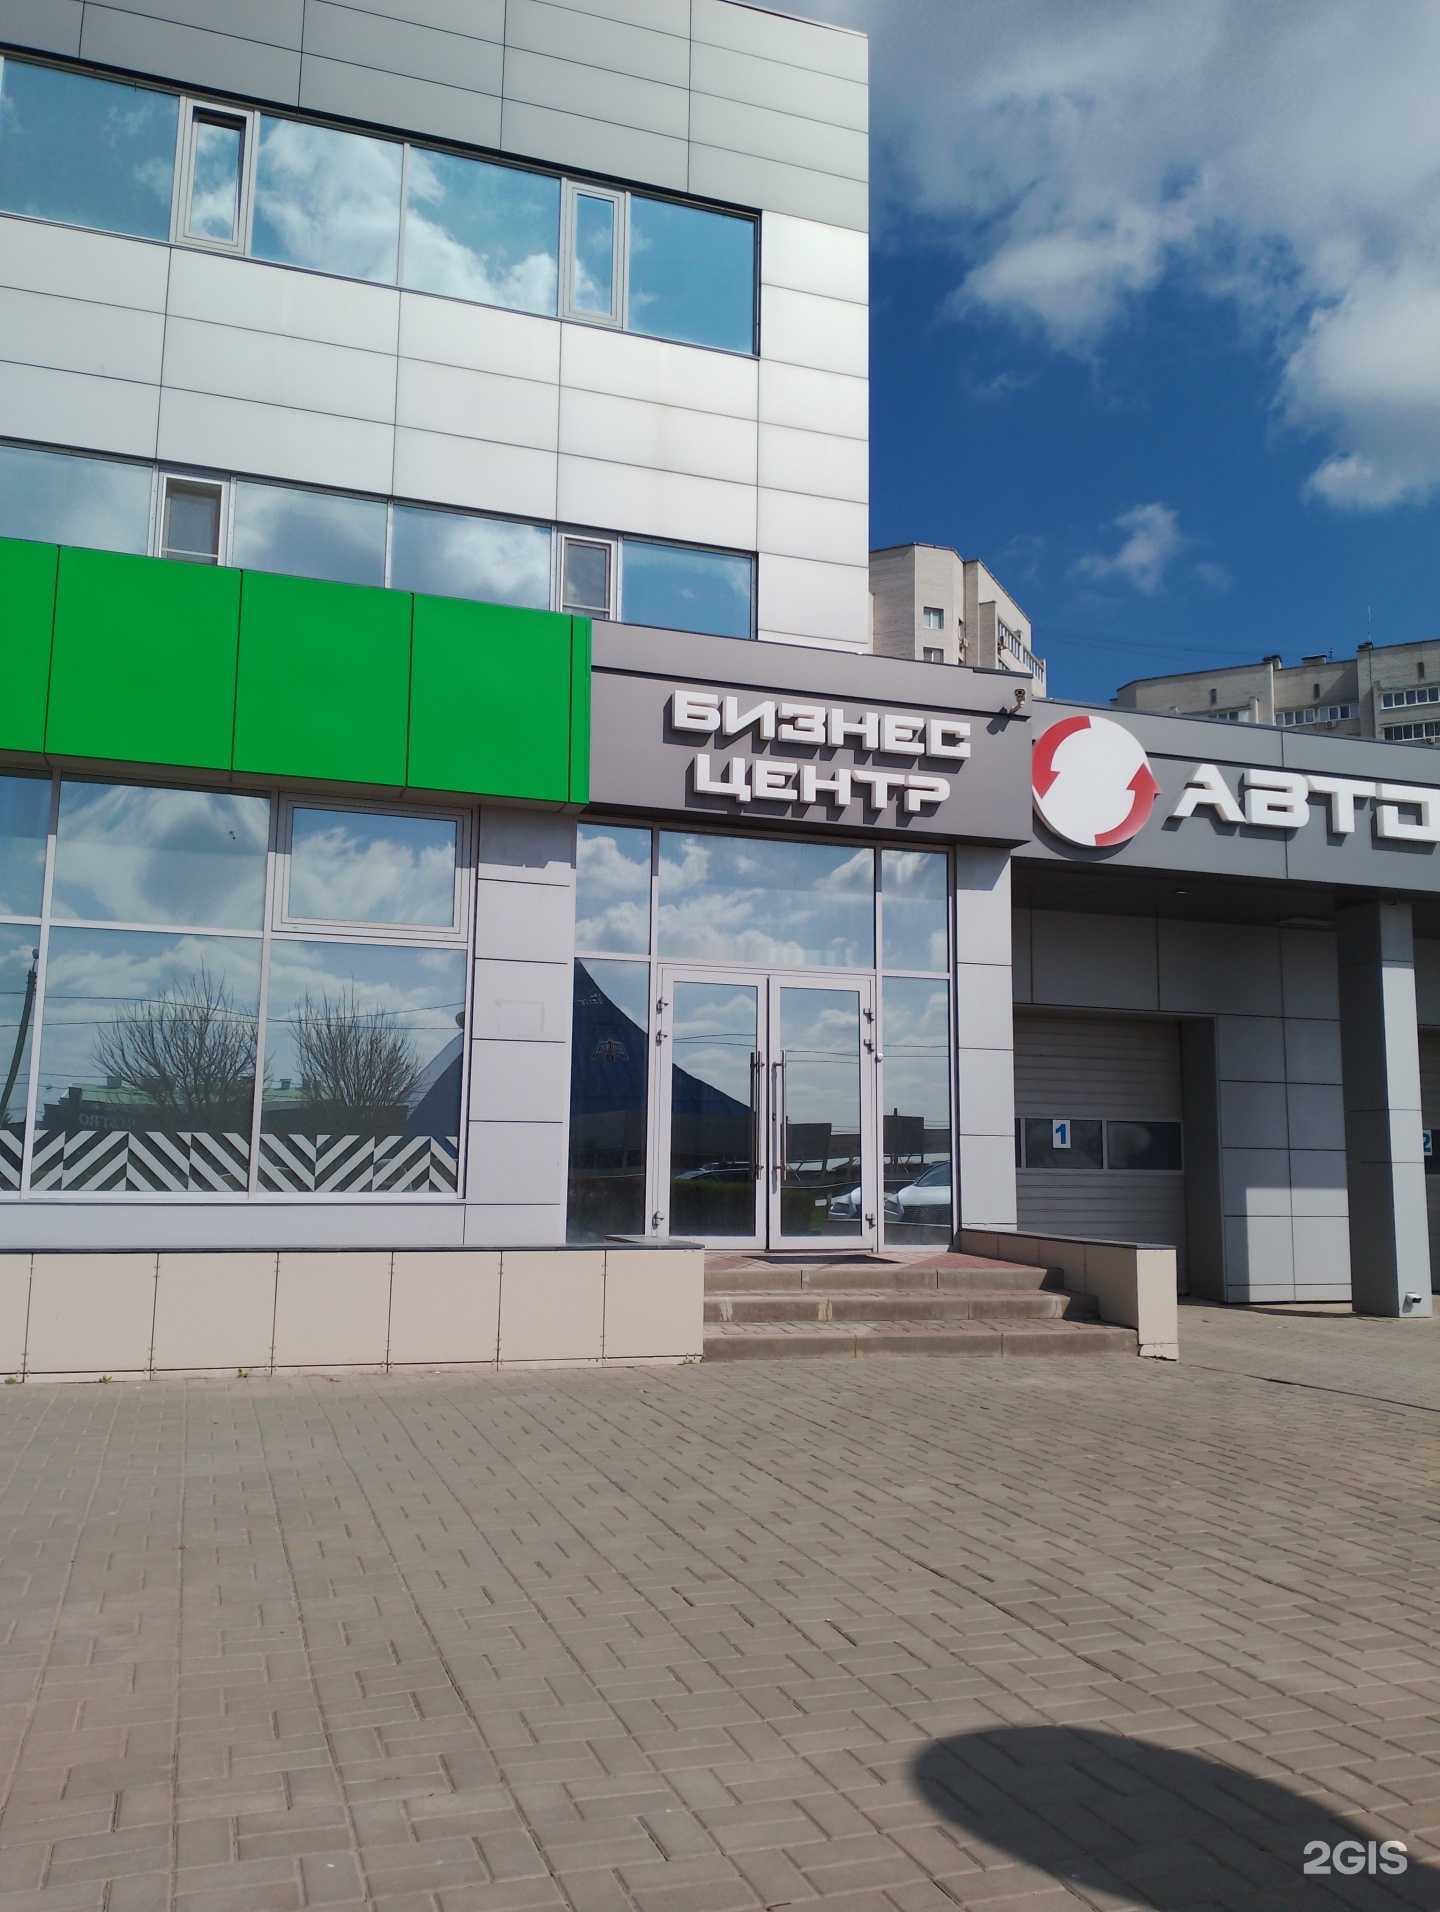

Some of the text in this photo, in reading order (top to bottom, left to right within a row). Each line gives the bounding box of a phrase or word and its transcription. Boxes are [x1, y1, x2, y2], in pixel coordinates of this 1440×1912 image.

[672, 690, 971, 759] БИЗНЕС
[693, 754, 951, 812] ЦЕНТР
[1172, 763, 1440, 842] АВТО
[1055, 1123, 1067, 1145] 1
